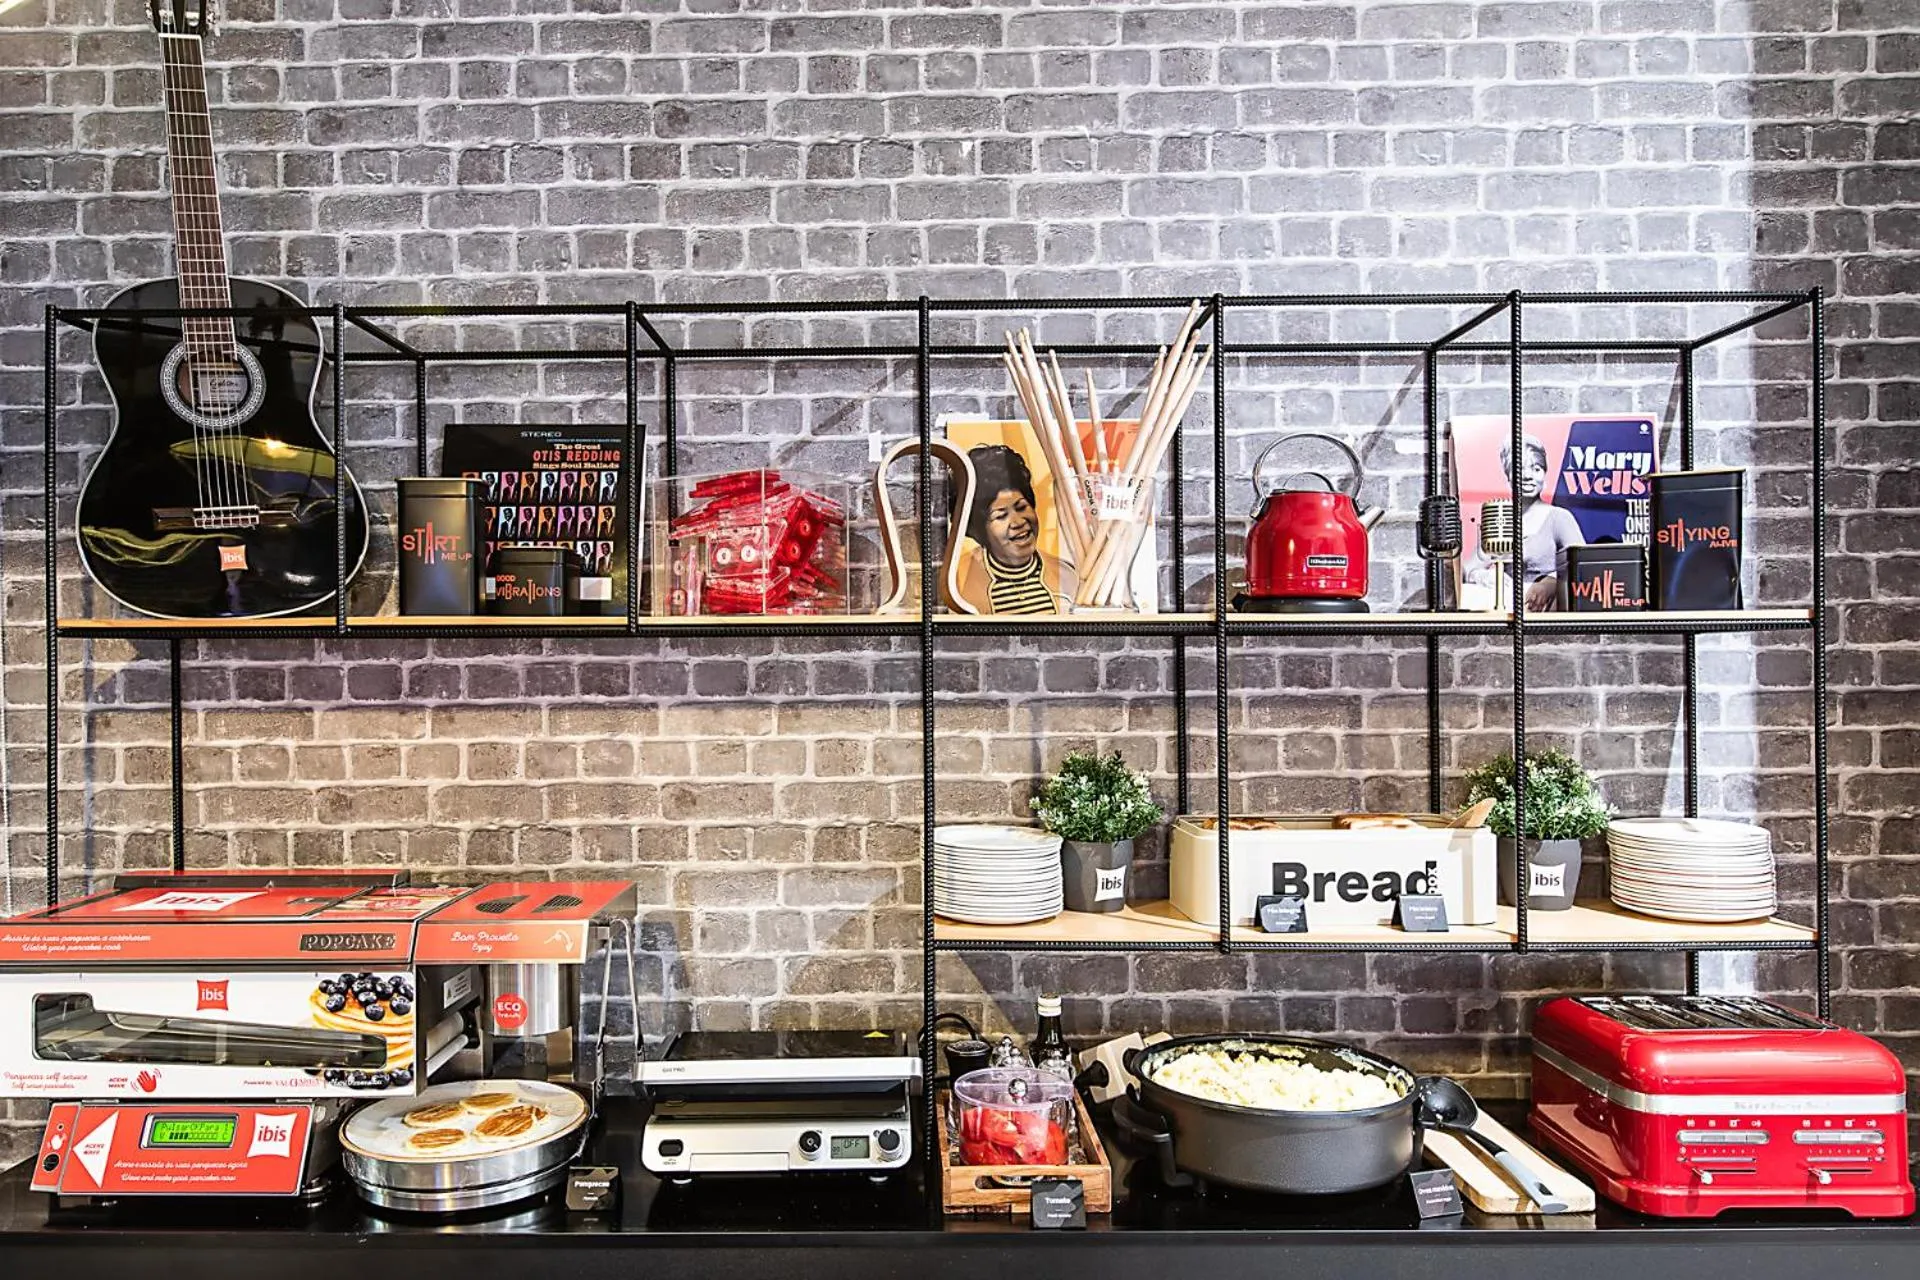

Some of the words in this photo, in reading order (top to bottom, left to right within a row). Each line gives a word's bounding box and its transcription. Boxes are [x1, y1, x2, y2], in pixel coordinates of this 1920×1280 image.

[533, 450, 561, 461] OTIS
[566, 450, 621, 462] REDDING
[1567, 446, 1652, 476] Mary
[532, 462, 559, 470] Sings
[1562, 469, 1647, 495] Wells
[1106, 494, 1129, 510] ibis
[1625, 498, 1650, 516] THE
[1625, 516, 1650, 533] ONE
[402, 521, 461, 565] START
[1656, 518, 1730, 553] STAYING
[1709, 540, 1738, 549] ALIVE
[441, 552, 457, 561] ME
[458, 553, 473, 561] UP
[496, 579, 561, 604] VIBRATIONS
[1571, 570, 1625, 609] WAKE
[1614, 598, 1631, 607] ME
[1632, 599, 1645, 607] UP
[1101, 876, 1122, 891] ibis
[1272, 861, 1437, 903] Bread
[1534, 872, 1561, 887] ibis
[305, 935, 397, 950] POPCAKE
[201, 987, 225, 1002] ibis
[497, 1001, 522, 1012] ECO
[256, 1125, 287, 1142] ibis
[842, 1139, 862, 1149] OFF
